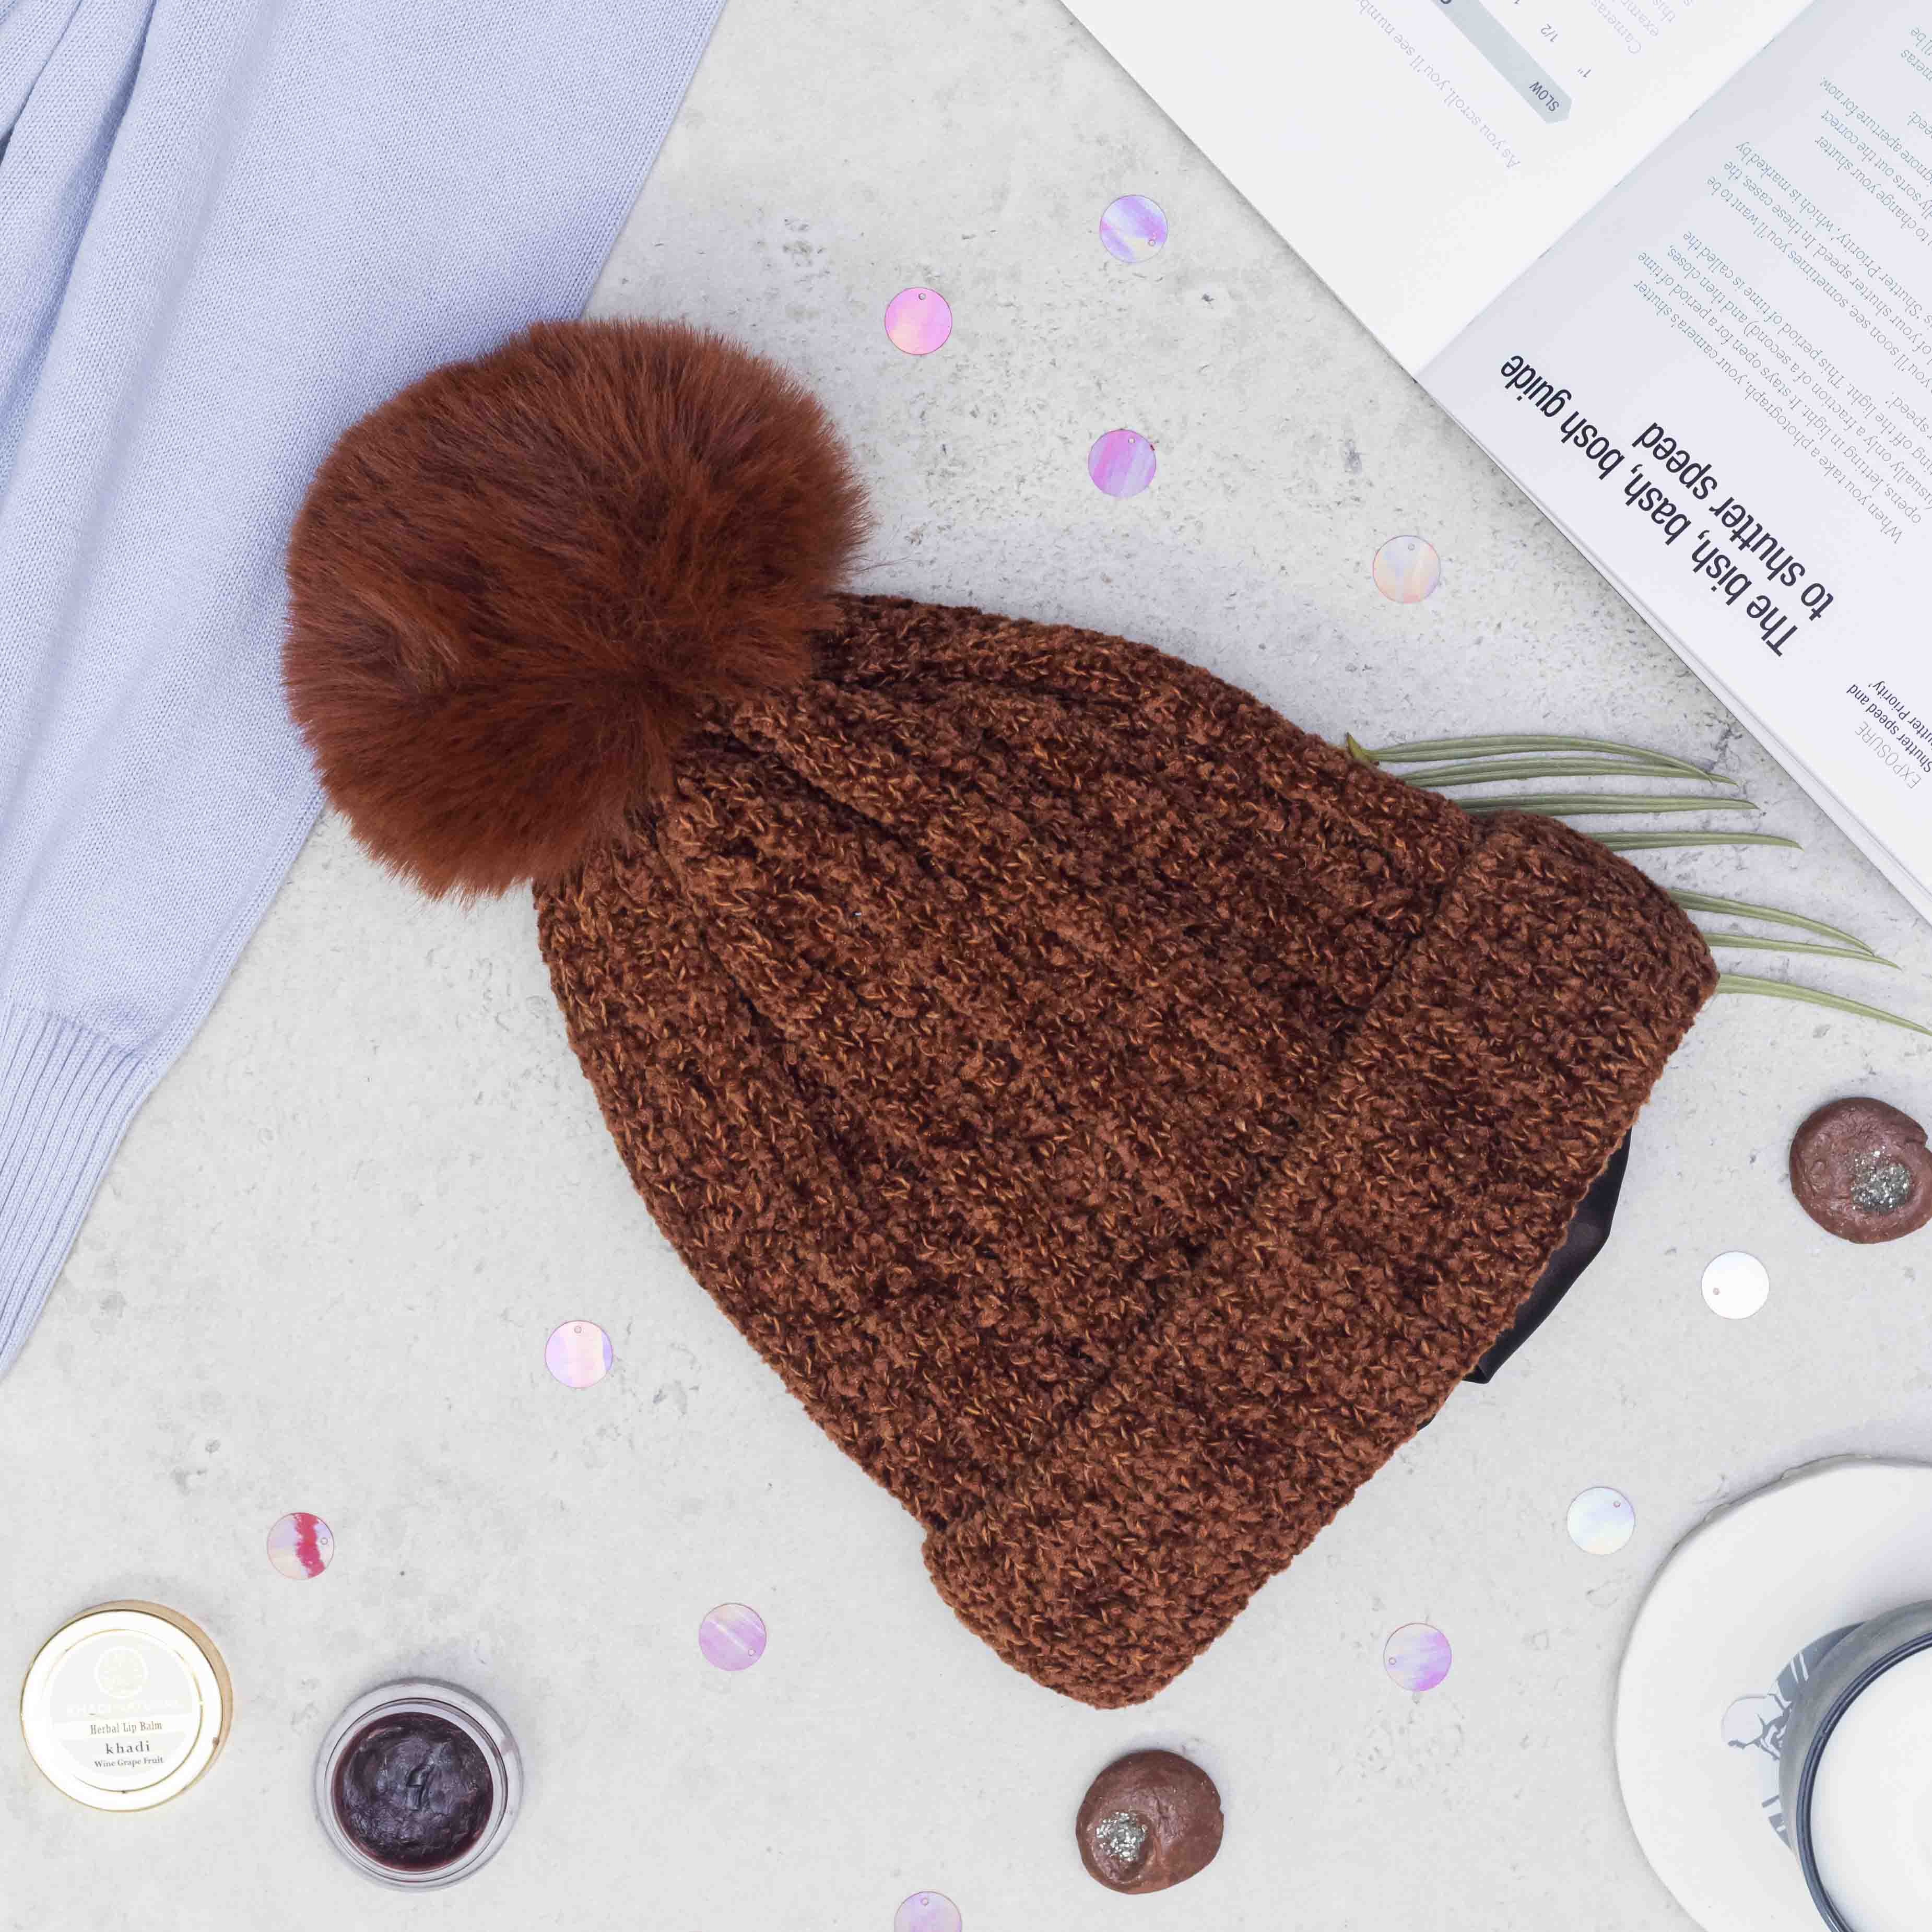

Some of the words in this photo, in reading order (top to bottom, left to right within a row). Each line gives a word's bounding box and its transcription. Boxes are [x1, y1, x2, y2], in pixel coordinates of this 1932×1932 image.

[1393, 34, 1416, 56] see
[1541, 23, 1558, 42] 1/2
[1911, 27, 1926, 48] be
[1410, 54, 1450, 91] you'll
[1529, 81, 1560, 112] SLOW
[1820, 77, 1844, 101] now.
[1444, 88, 1481, 126] scroll,
[1840, 98, 1859, 117] for
[1480, 125, 1506, 150] you
[1821, 109, 1859, 144] correct
[1857, 111, 1902, 152] aperture
[1502, 148, 1521, 169] As
[1735, 142, 1752, 161] by
[1815, 136, 1854, 171] shutter
[1857, 142, 1876, 163] the
[1724, 161, 1742, 180] the
[1746, 150, 1792, 193] marked
[1851, 169, 1882, 194] your
[1874, 157, 1894, 177] out
[1707, 176, 1722, 197] be
[1721, 189, 1734, 203] to
[1742, 175, 1773, 206] cases,
[1789, 189, 1803, 204] is
[1893, 175, 1922, 201] sorts
[1730, 197, 1759, 226] want
[1772, 205, 1803, 234] these
[1799, 197, 1834, 232] which
[1876, 191, 1917, 230] change
[1683, 231, 1702, 251] the
[1753, 221, 1793, 255] you'll
[1801, 230, 1817, 250] In
[1913, 226, 1929, 242] to
[1638, 251, 1663, 278] time
[1667, 245, 1700, 280] closes,
[1696, 246, 1734, 279] called
[1813, 243, 1853, 282] speed.
[1830, 228, 1882, 280] Priority',
[1656, 270, 1676, 286] of
[1700, 277, 1726, 304] then
[1733, 277, 1746, 292] is
[1788, 251, 1849, 309] sometimes
[1633, 280, 1672, 317] shutter
[1668, 284, 1713, 320] period
[1744, 287, 1772, 315] time
[1849, 277, 1892, 317] shutter
[1878, 273, 1922, 320] 'Shutter
[1709, 316, 1717, 326] a
[1720, 301, 1748, 324] and
[1763, 308, 1783, 326] of
[1849, 305, 1871, 329] see,
[1670, 313, 1717, 362] camera's
[1715, 324, 1734, 347] for
[1742, 321, 1792, 365] second)
[1777, 322, 1823, 362] period
[1870, 326, 1902, 356] soon
[1888, 315, 1922, 343] your
[1730, 339, 1763, 368] open
[1912, 341, 1931, 355] of
[1715, 358, 1748, 385] your
[1790, 361, 1800, 372] a
[1792, 370, 1812, 385] of
[1818, 358, 1846, 389] This
[1892, 354, 1932, 389] you'll
[1501, 356, 1572, 418] guide
[1760, 368, 1792, 397] stays
[1743, 380, 1815, 451] photograph,
[1788, 394, 1804, 411] It
[1811, 383, 1858, 432] fraction
[1847, 383, 1877, 420] light.
[1885, 392, 1929, 434] speed'.
[1801, 405, 1832, 441] light.
[1856, 426, 1868, 437] a
[1876, 413, 1896, 435] the
[1560, 411, 1625, 481] bosh
[1811, 447, 1821, 458] a
[1831, 434, 1846, 452] in
[1863, 435, 1892, 462] only
[1889, 431, 1913, 450] off
[1631, 422, 1717, 500] speed
[1819, 456, 1846, 485] take
[1842, 446, 1884, 492] letting
[1624, 464, 1692, 546] bash,
[1844, 481, 1872, 506] you
[1884, 484, 1922, 526] opens,
[1867, 503, 1905, 545] When
[1709, 497, 1806, 587] shutter
[1692, 530, 1753, 606] bish,
[1801, 583, 1834, 621] to
[1747, 595, 1798, 657] The
[1846, 684, 1870, 705] and
[1868, 681, 1911, 721] Priority'
[1865, 703, 1900, 735] speed
[1855, 721, 1922, 789] EXPOSURE
[1896, 734, 1932, 773] Shutter
[90, 1724, 120, 1735] Herbal
[123, 1722, 137, 1734] Lip
[139, 1721, 162, 1731] Balm
[105, 1740, 150, 1754] khadi
[117, 1758, 142, 1768] Grape
[144, 1756, 163, 1764] Fruit
